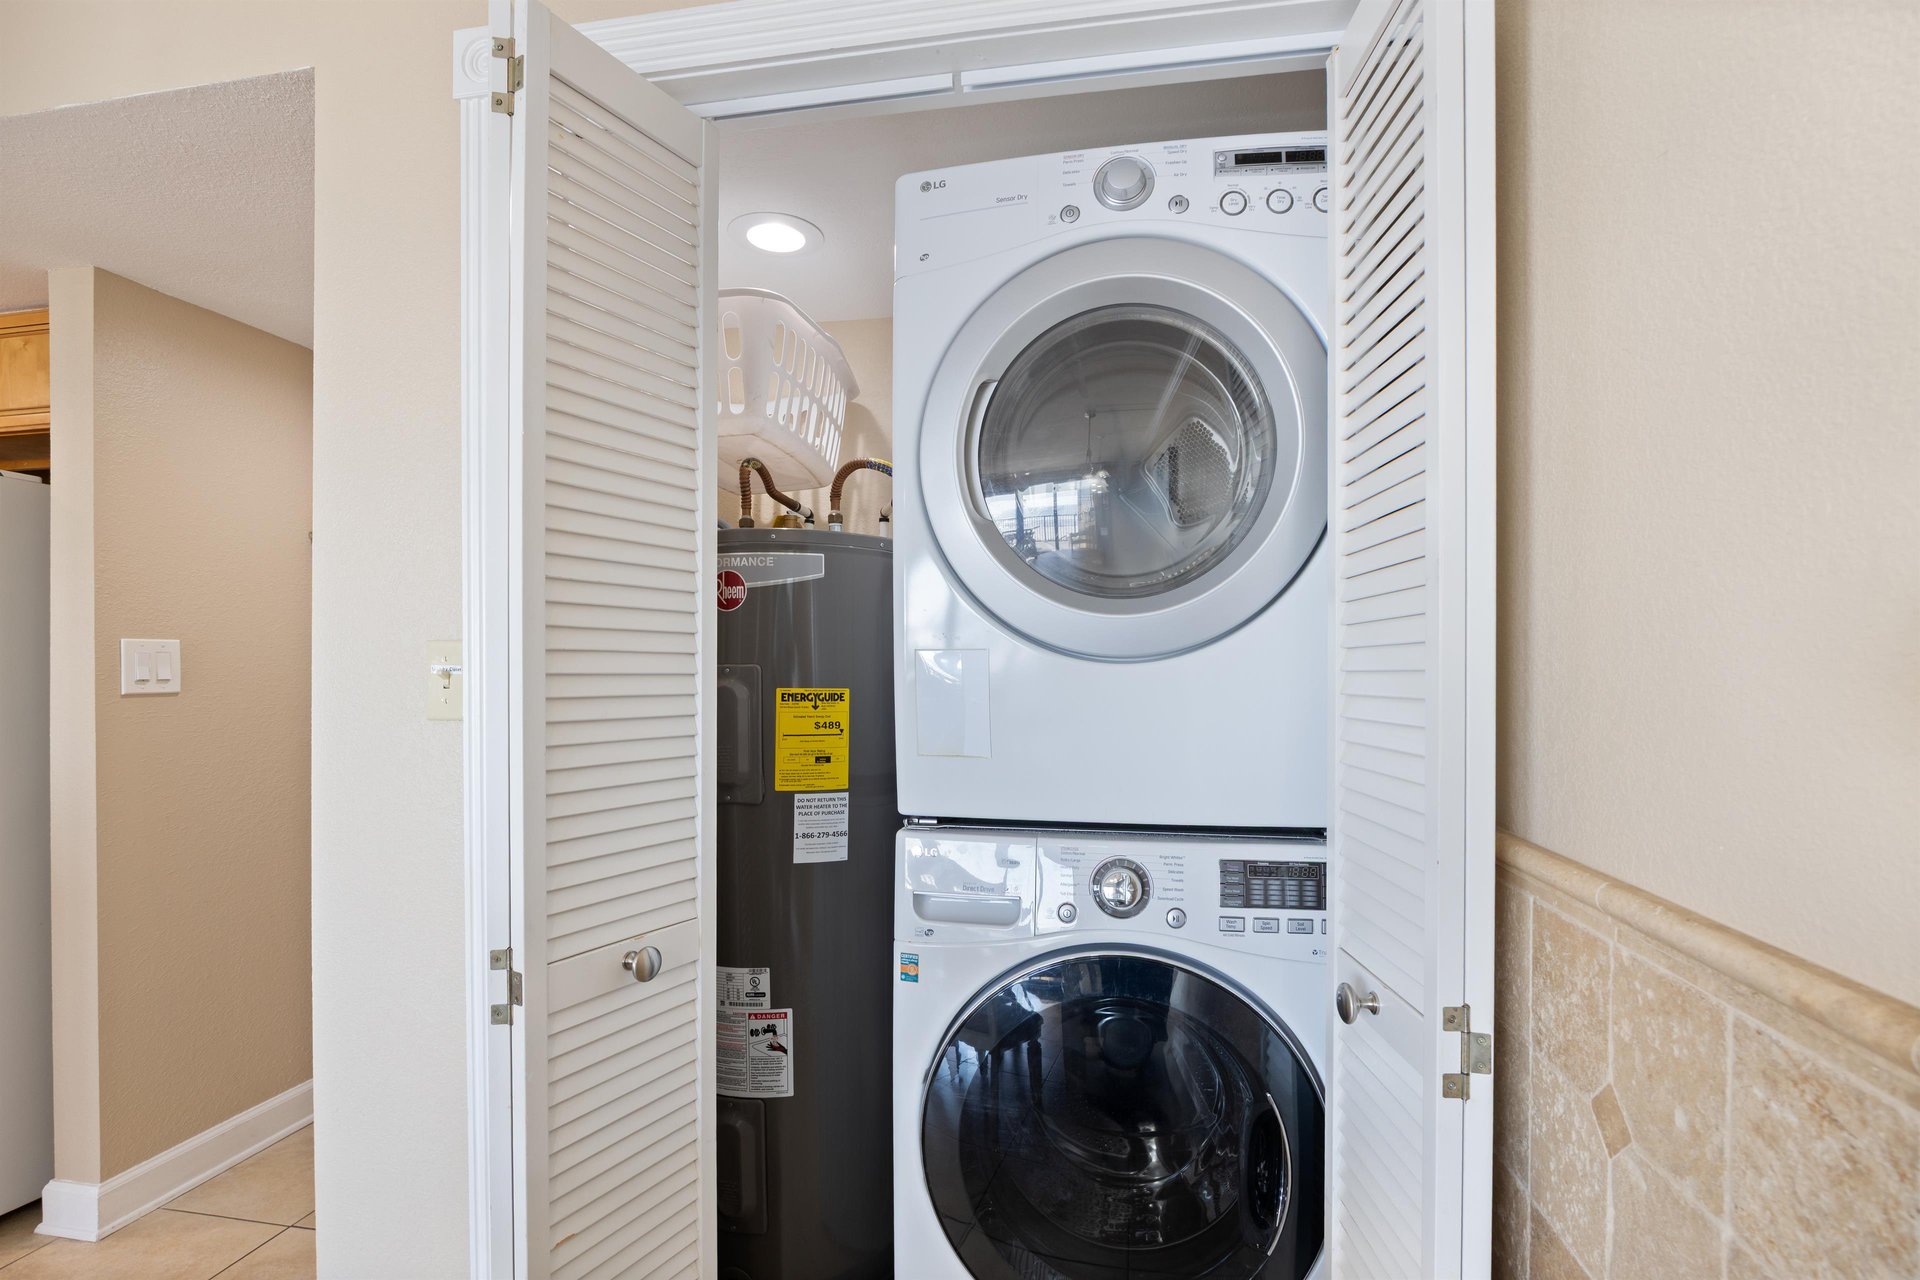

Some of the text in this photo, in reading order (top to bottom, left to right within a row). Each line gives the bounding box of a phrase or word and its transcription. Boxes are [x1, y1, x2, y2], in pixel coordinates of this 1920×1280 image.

[995, 195, 1016, 203] Sensor
[717, 557, 774, 567] ORMANCE
[781, 692, 845, 702] ENERGYGUIDE
[814, 721, 841, 730] $489
[795, 830, 848, 839] 1-866-279-4566
[962, 884, 995, 893] Direct Drive
